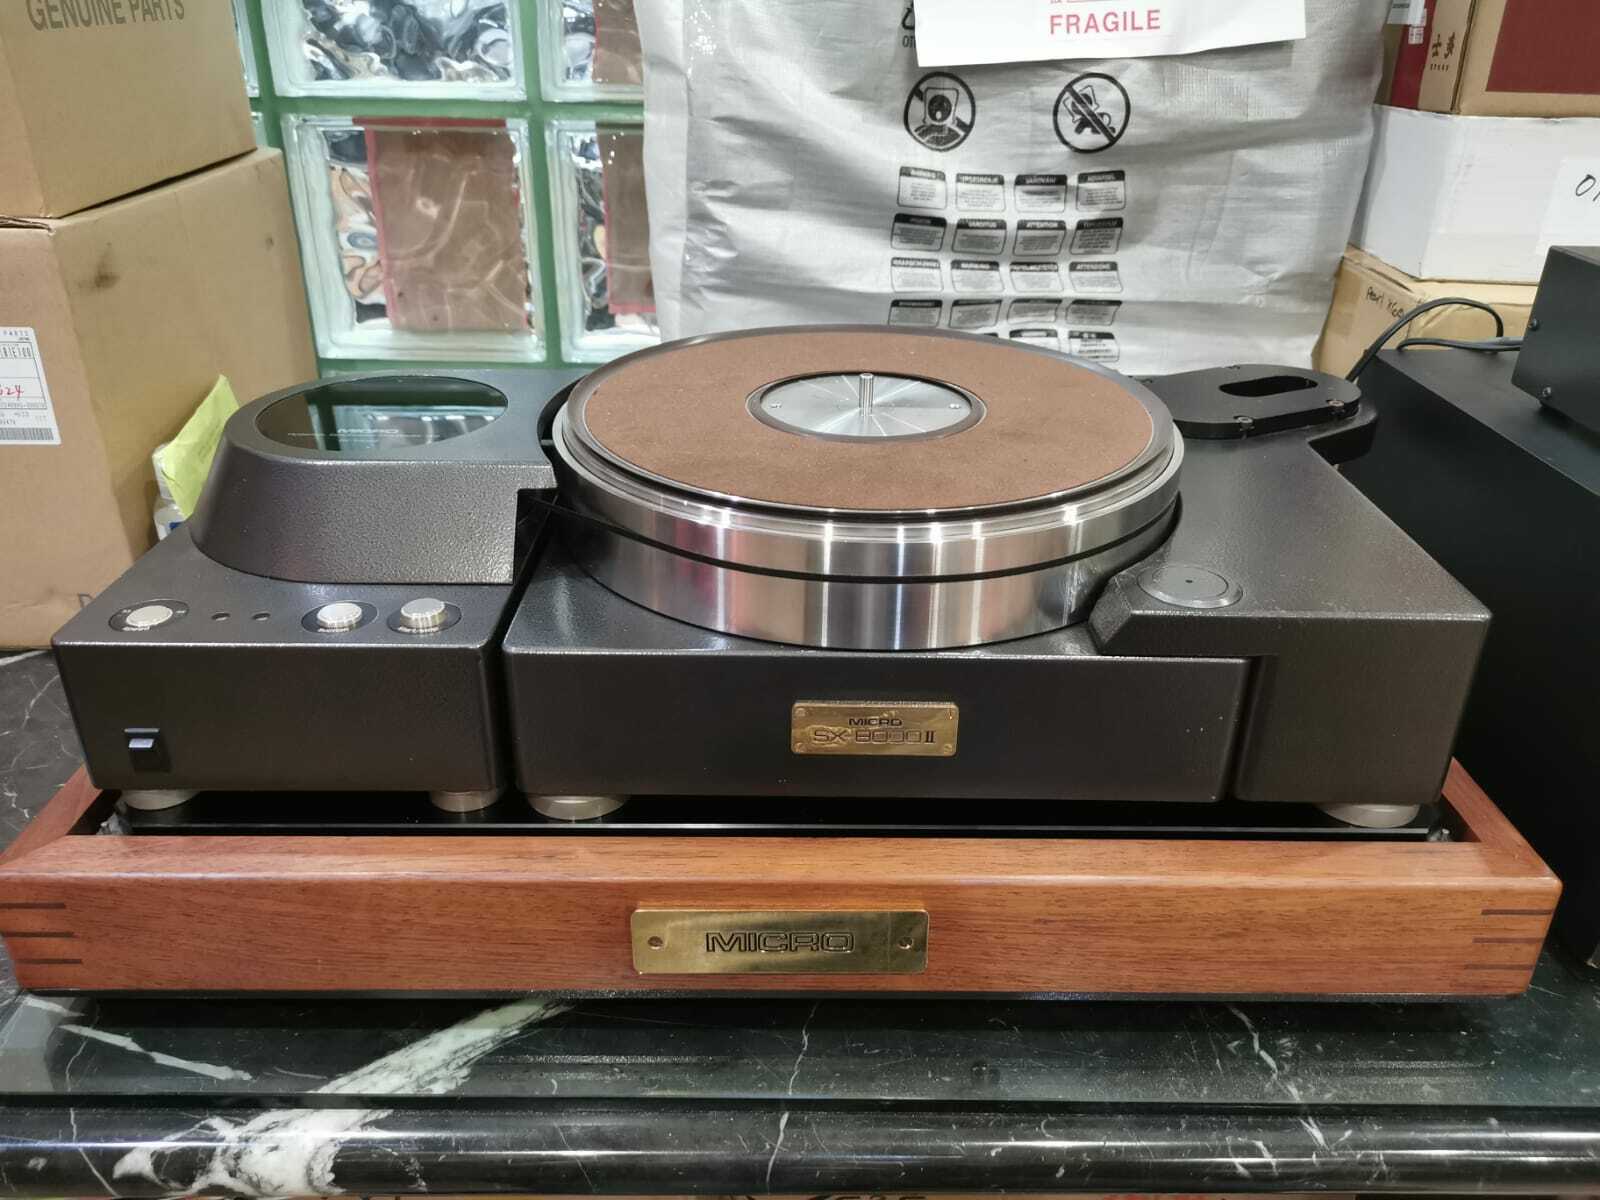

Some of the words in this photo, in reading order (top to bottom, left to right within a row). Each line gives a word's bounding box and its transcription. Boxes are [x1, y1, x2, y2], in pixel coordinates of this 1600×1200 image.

[26, 0, 126, 31] GENUINE
[128, 0, 185, 22] PARTS
[1050, 9, 1161, 35] FRAGILE
[849, 718, 903, 726] MICRO
[705, 931, 855, 953] MICRO
